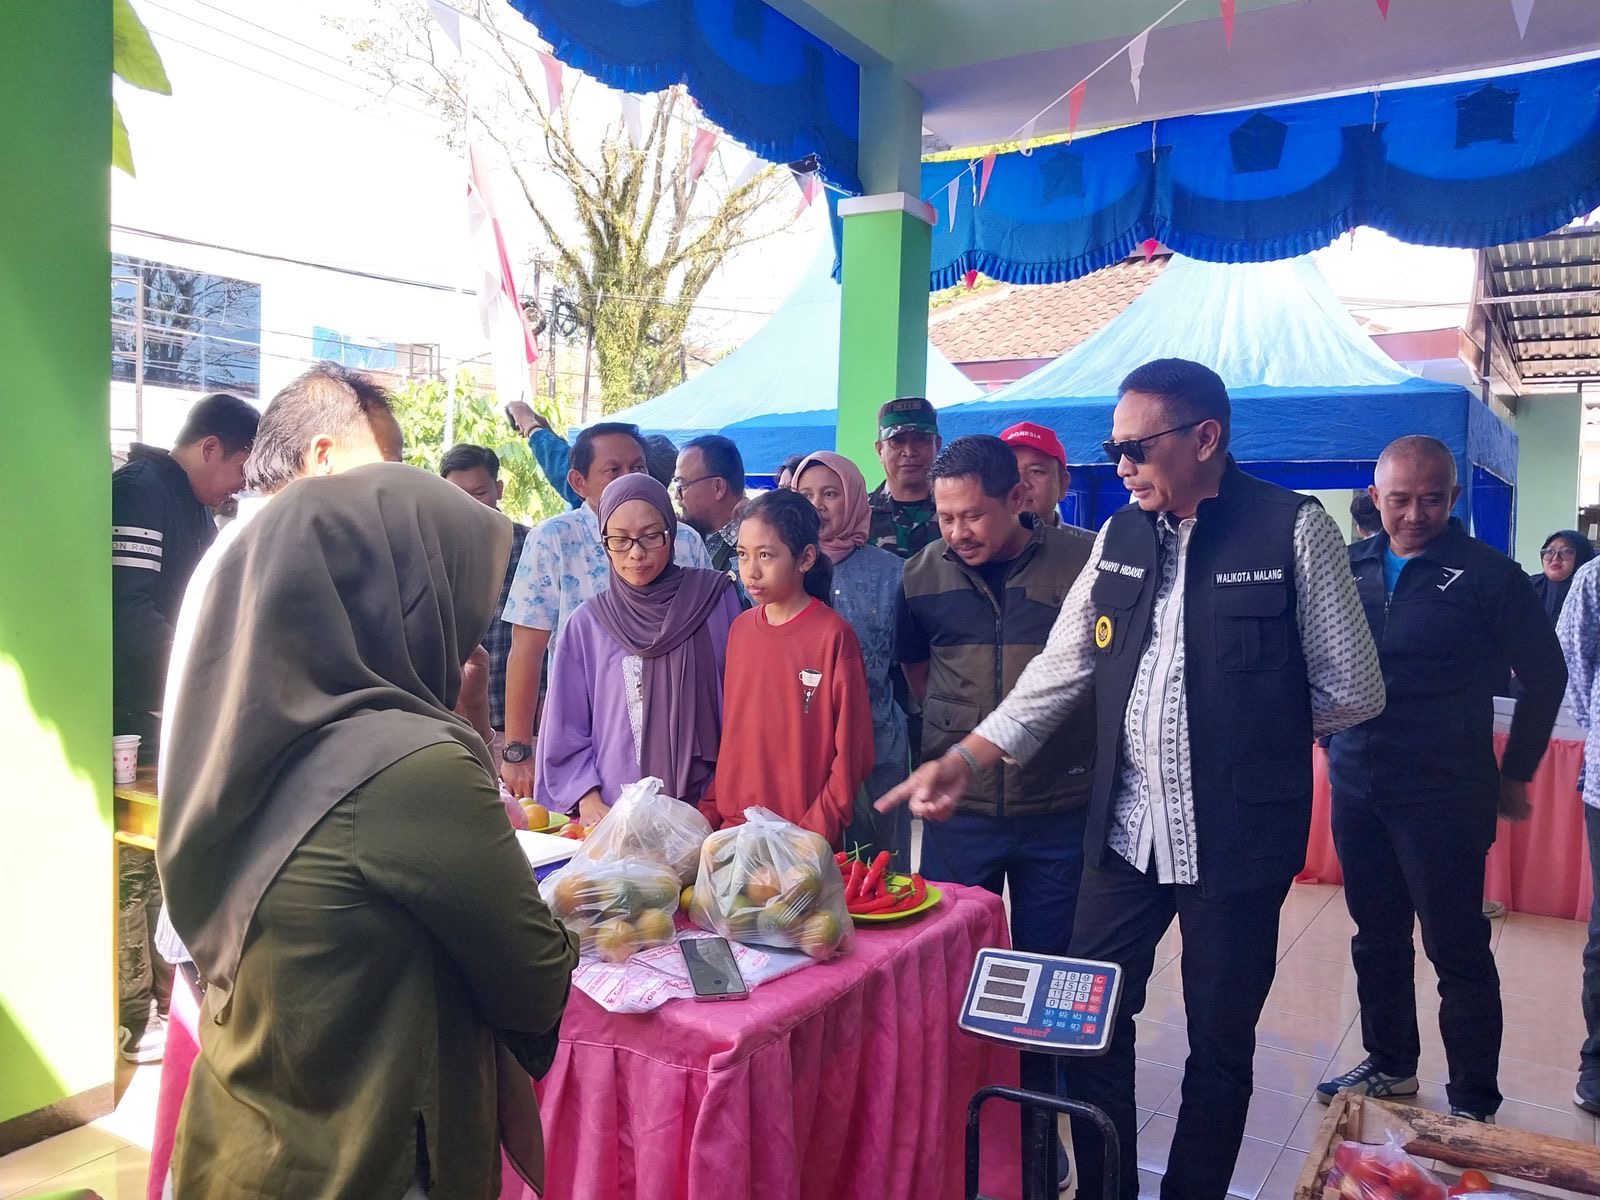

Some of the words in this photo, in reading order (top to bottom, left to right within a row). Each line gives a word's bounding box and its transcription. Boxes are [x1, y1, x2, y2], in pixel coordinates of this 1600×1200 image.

[1098, 560, 1118, 573] WAHYU
[1120, 564, 1145, 579] HIDAYAT
[1216, 572, 1251, 584] WALIKOTA
[1253, 568, 1282, 581] MALANG
[1058, 1010, 1068, 1018] M2
[1072, 1012, 1082, 1020] M3
